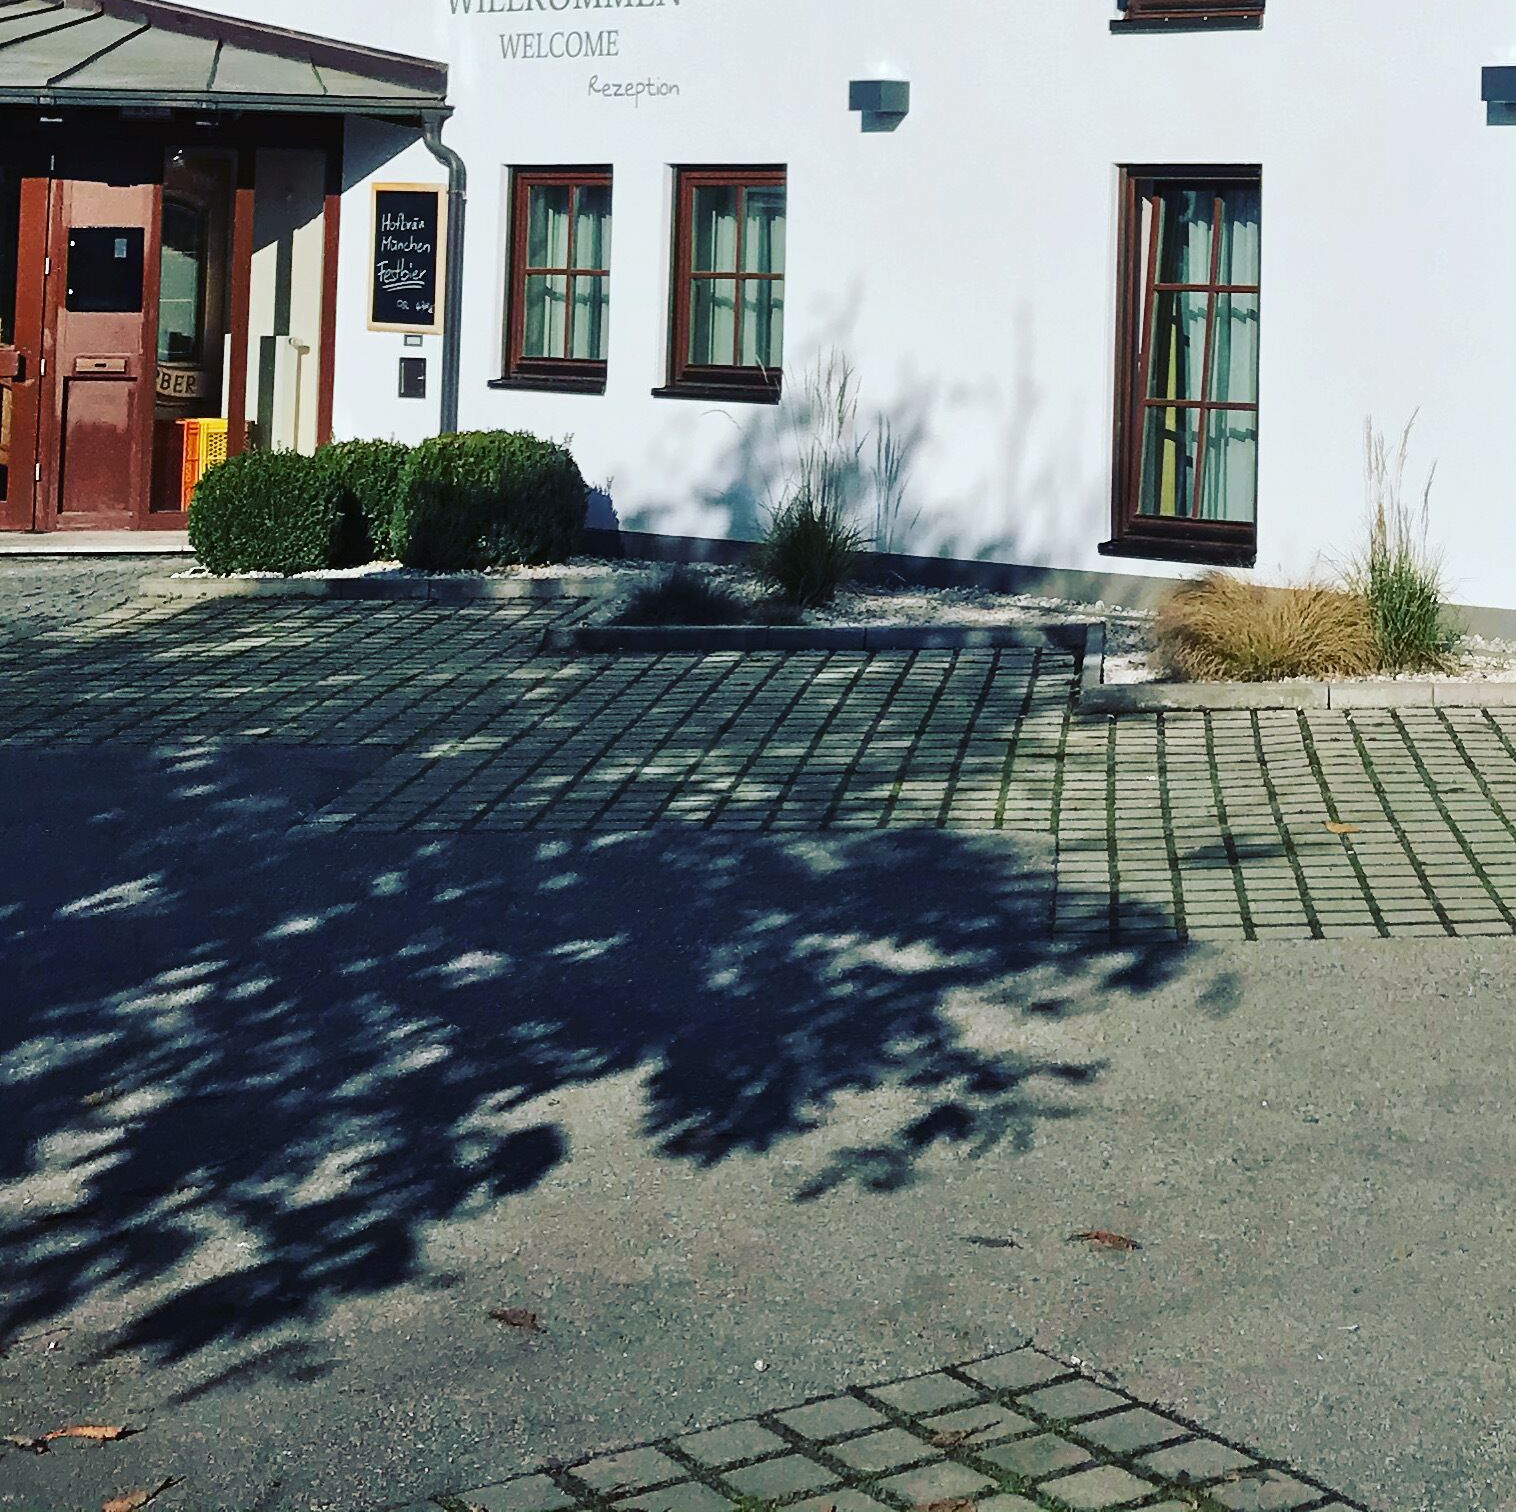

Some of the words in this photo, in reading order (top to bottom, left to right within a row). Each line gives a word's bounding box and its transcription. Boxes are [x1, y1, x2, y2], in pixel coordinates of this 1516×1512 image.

[499, 30, 619, 59] WELCOME
[588, 74, 680, 108] Rezeption
[381, 235, 431, 253] München
[377, 258, 426, 283] Festbier
[156, 369, 196, 394] BER
